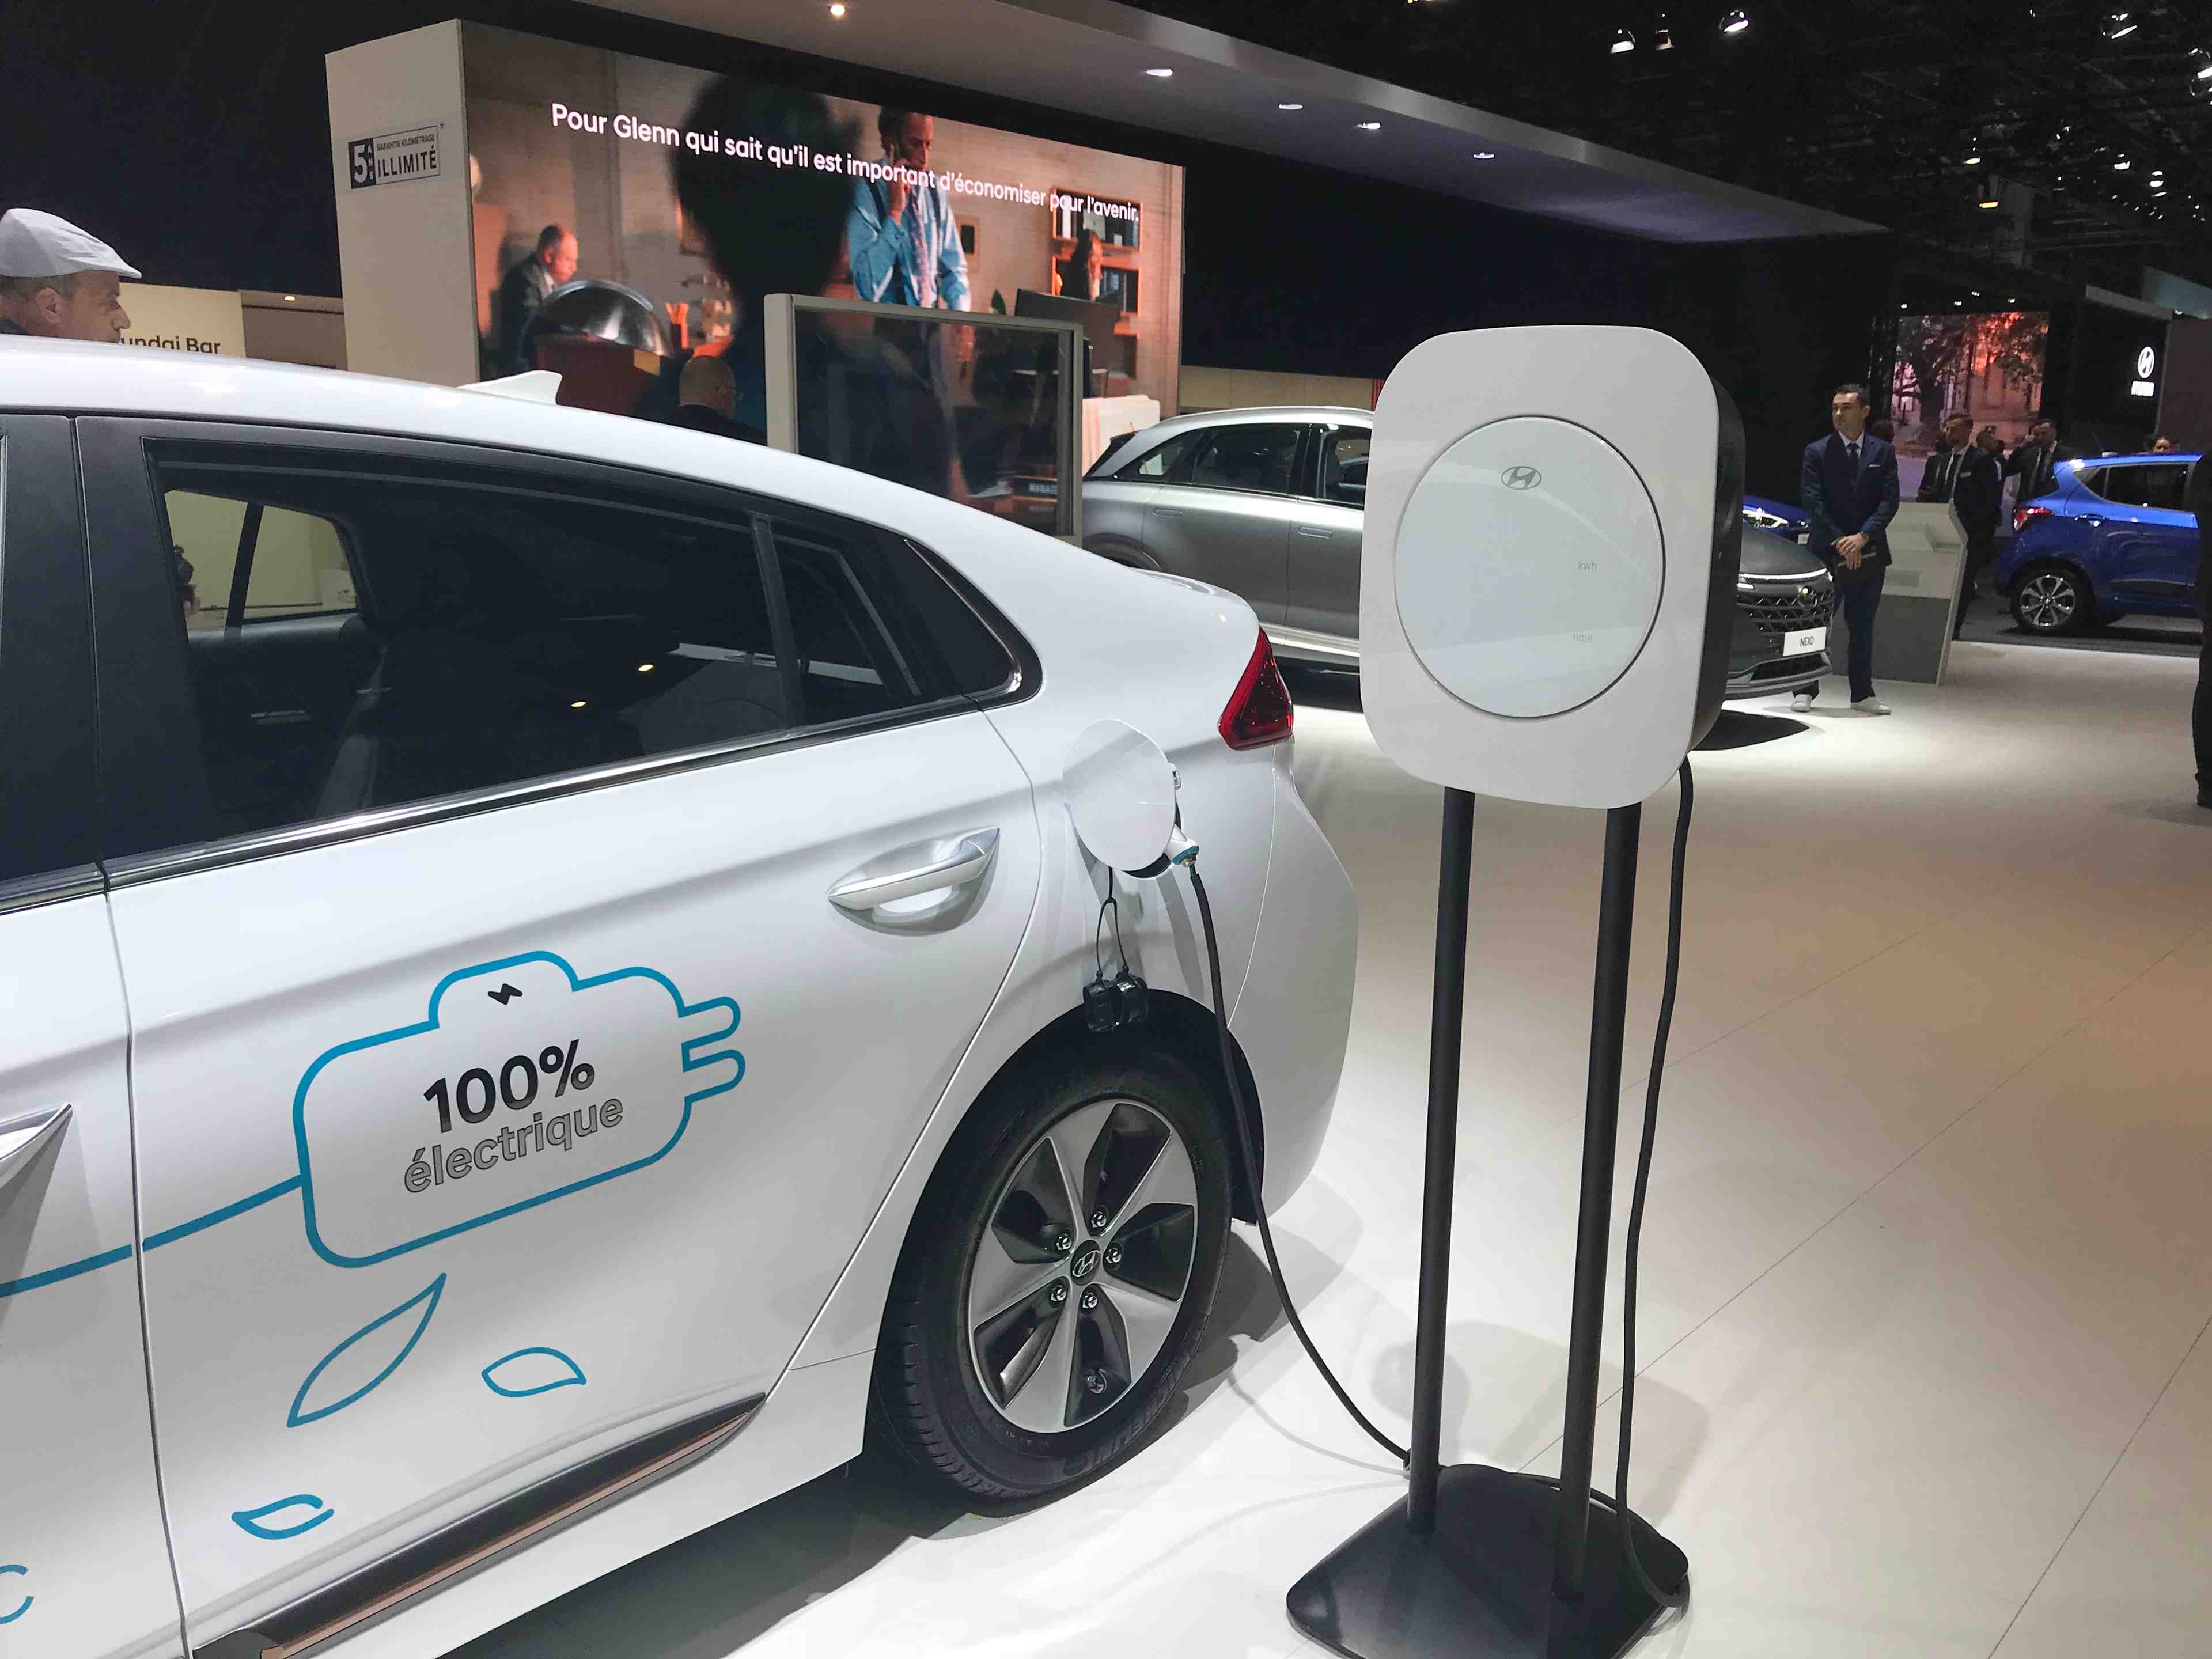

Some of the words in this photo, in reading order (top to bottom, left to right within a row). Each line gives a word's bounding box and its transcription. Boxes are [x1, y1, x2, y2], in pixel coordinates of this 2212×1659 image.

[354, 144, 368, 183] 5
[377, 144, 437, 178] ILLIMITÉ
[551, 103, 608, 134] Pour
[613, 114, 680, 147] Glenn
[685, 130, 719, 156] qui
[724, 136, 763, 161] sait
[767, 145, 809, 168] qu'il
[813, 153, 843, 174] est
[847, 153, 936, 189] important
[940, 170, 1047, 206] d'économiser
[1050, 194, 1084, 213] pour
[1087, 195, 1139, 222] l'avenir.
[120, 335, 180, 350] undai
[185, 337, 221, 355] Bar
[423, 1038, 596, 1134] 100%
[404, 1097, 624, 1194] électrique
